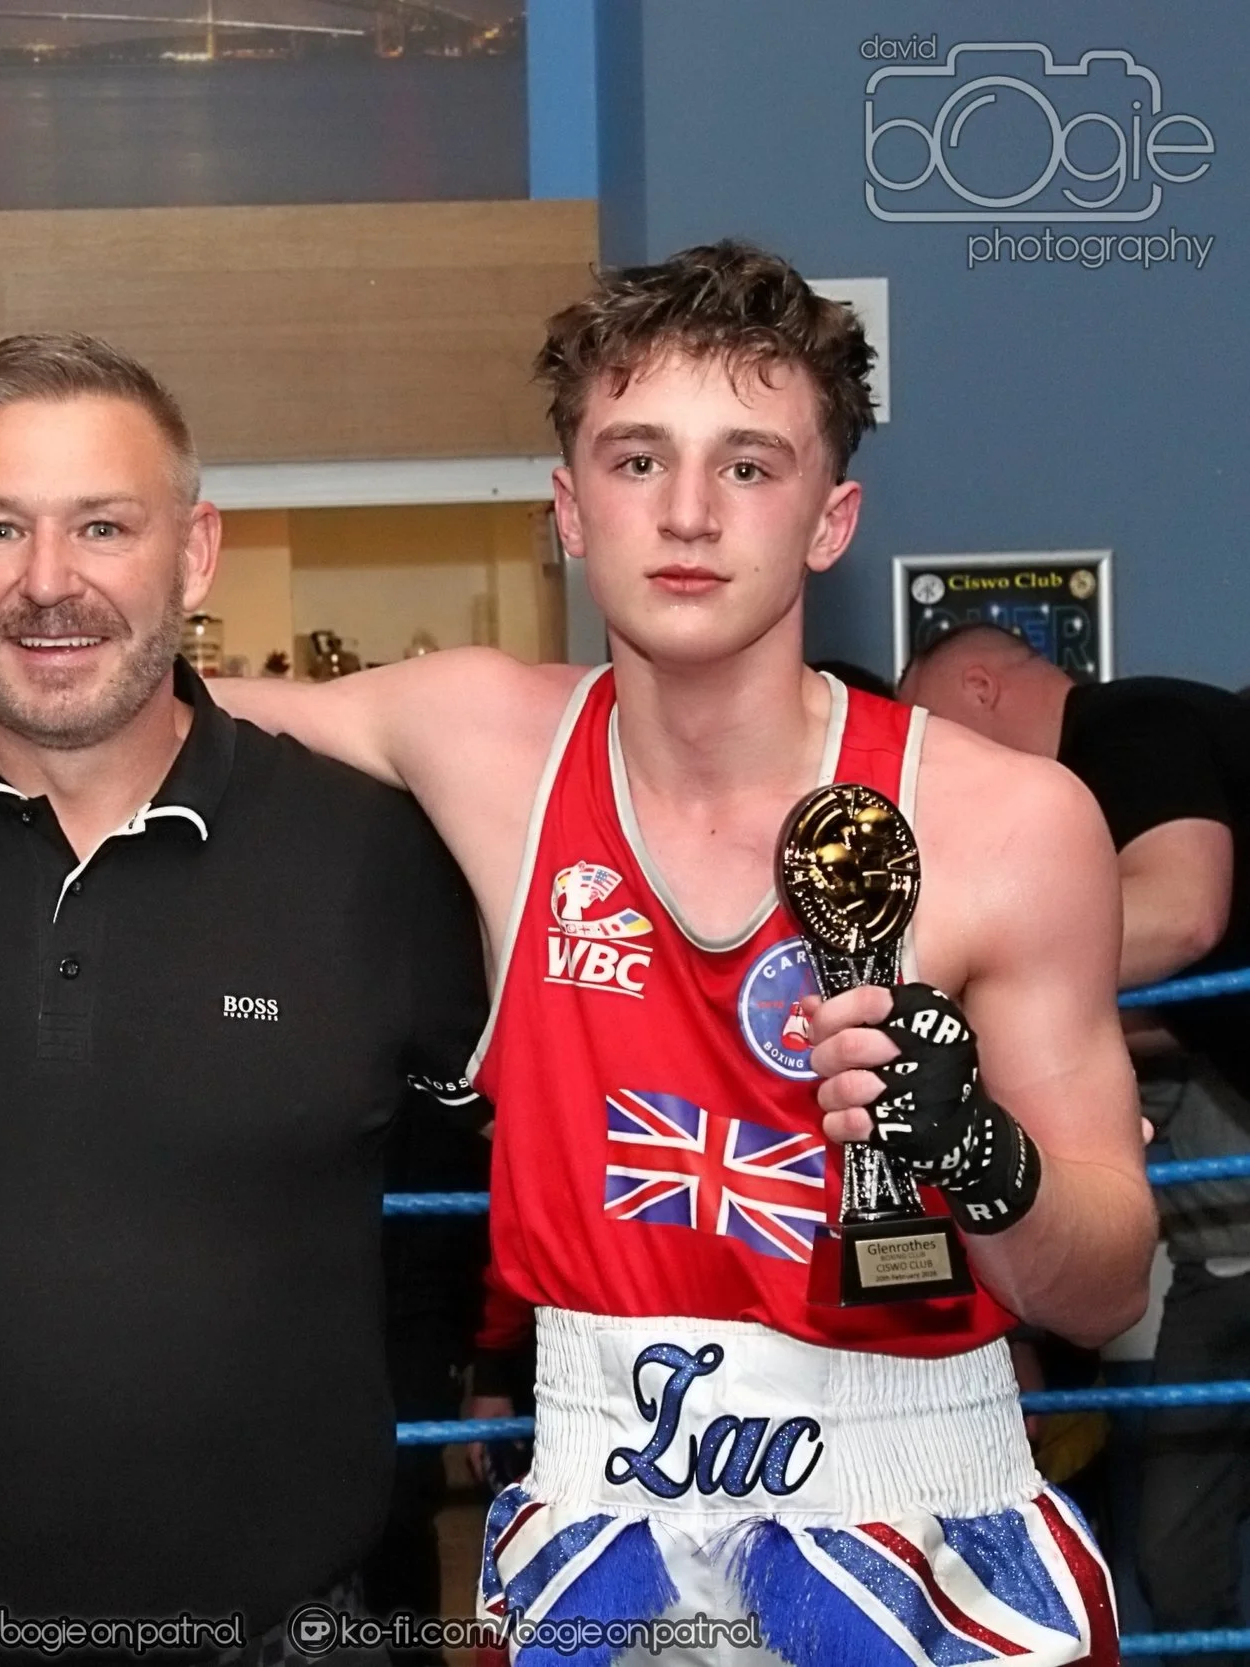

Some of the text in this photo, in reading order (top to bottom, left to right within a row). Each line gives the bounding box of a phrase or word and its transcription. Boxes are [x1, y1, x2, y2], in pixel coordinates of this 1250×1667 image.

[949, 572, 1063, 591] Ciswo Club
[548, 936, 651, 992] WBC
[223, 995, 279, 1015] BOSS
[763, 1041, 805, 1069] BOXING
[867, 1240, 936, 1256] Glenrothes
[876, 1259, 933, 1273] CISWO CLUB
